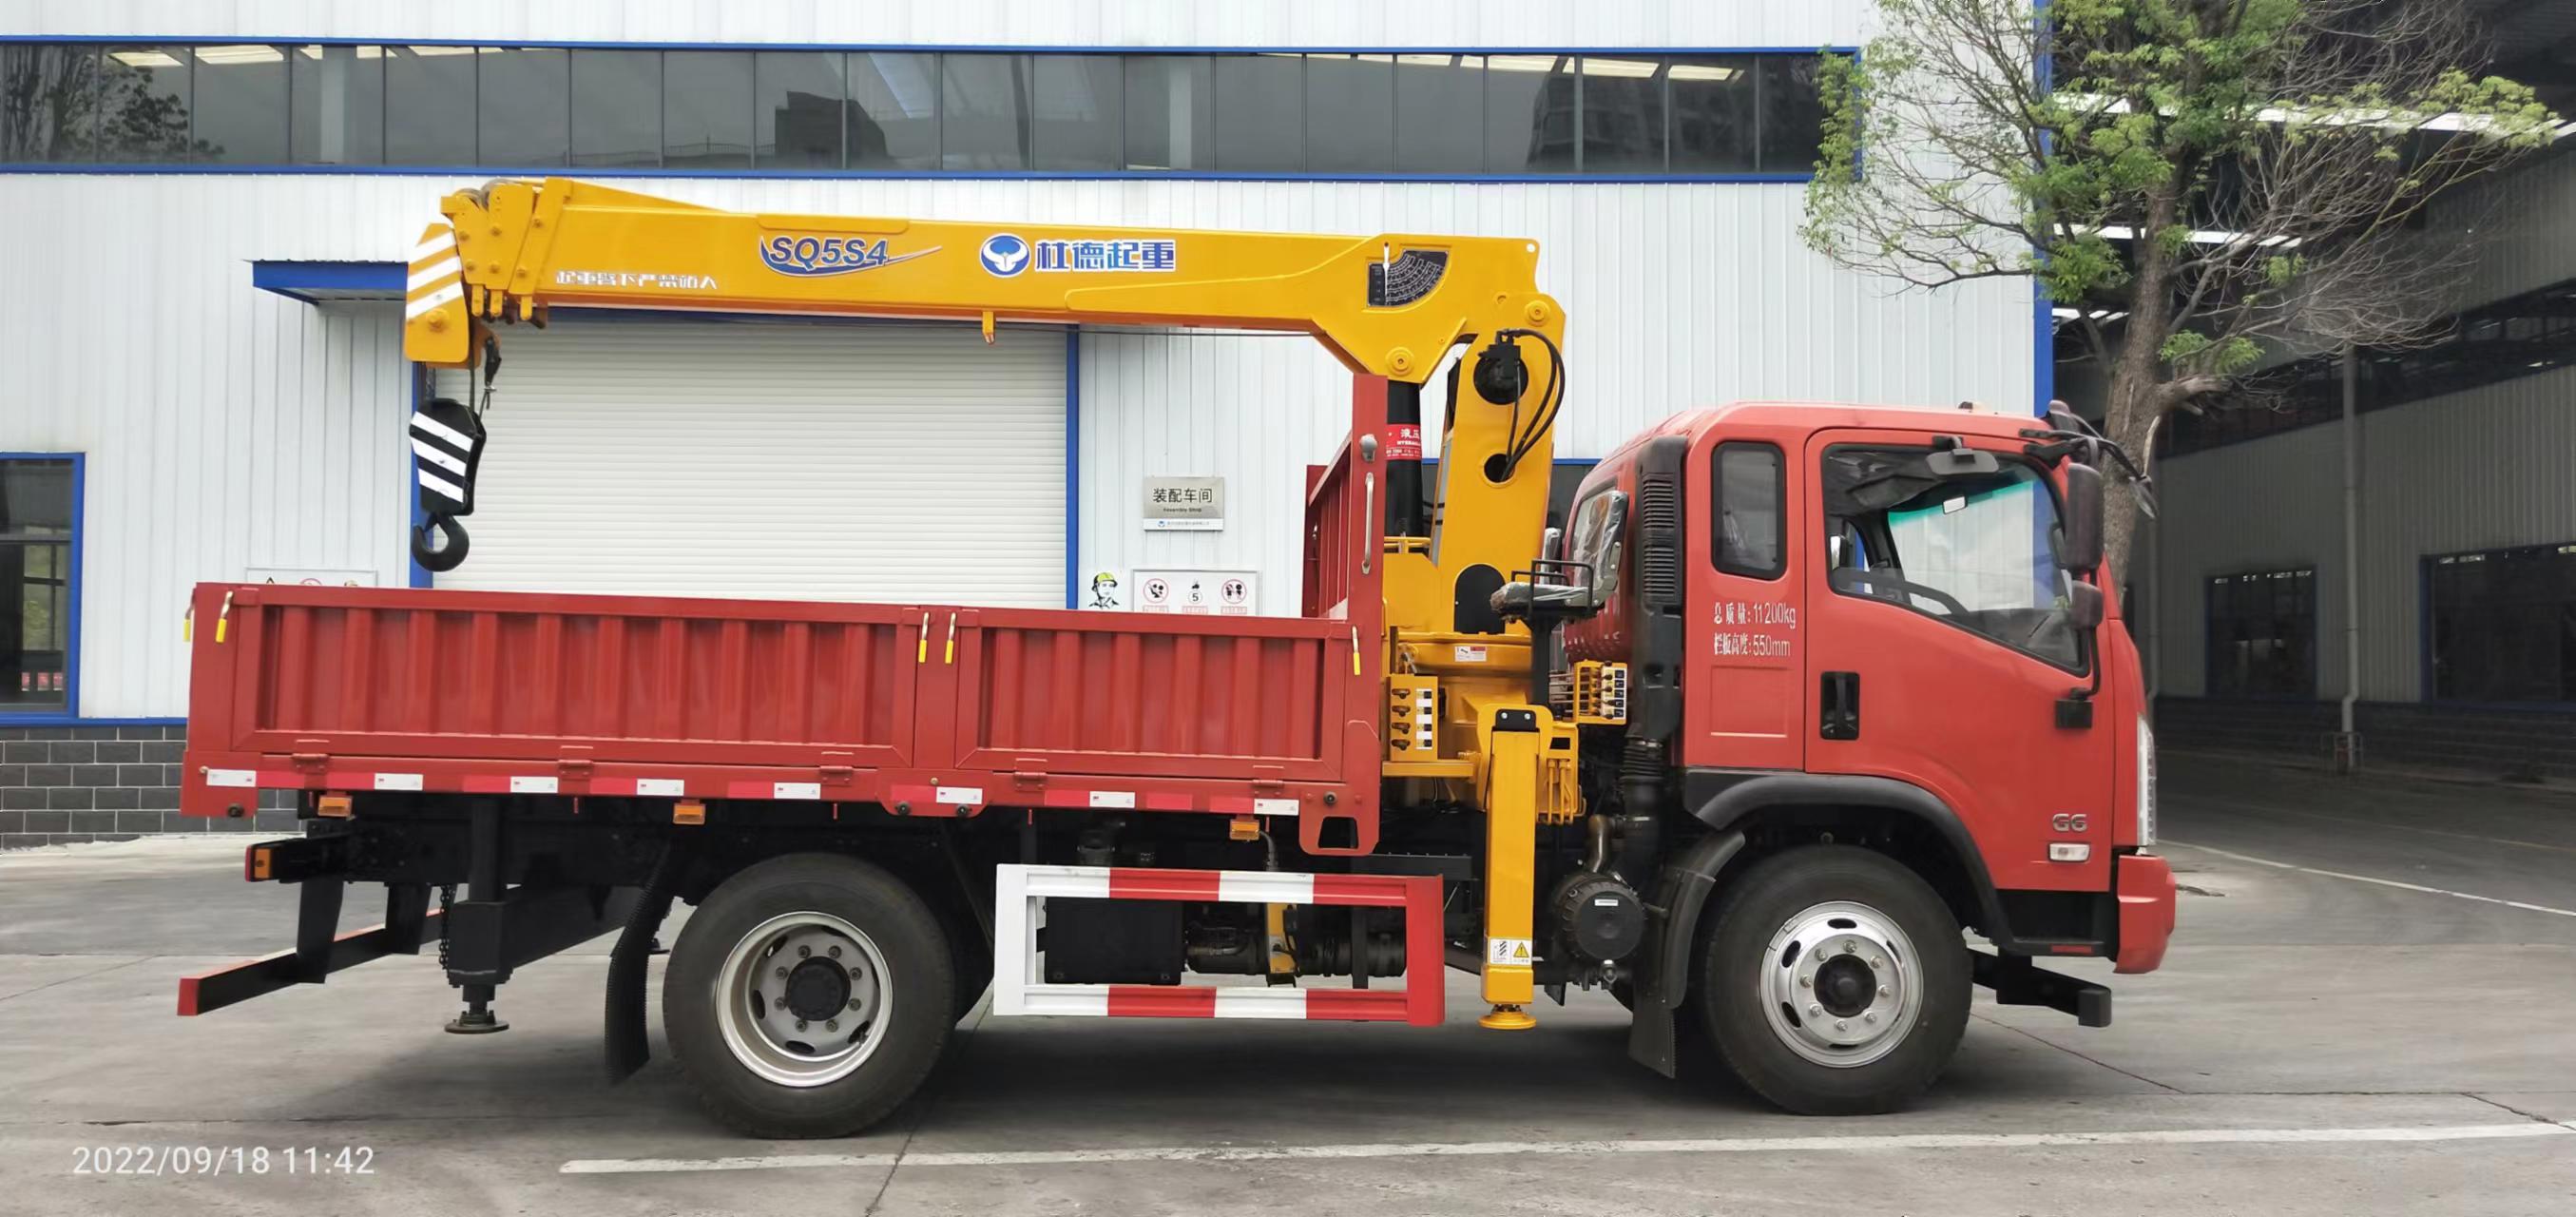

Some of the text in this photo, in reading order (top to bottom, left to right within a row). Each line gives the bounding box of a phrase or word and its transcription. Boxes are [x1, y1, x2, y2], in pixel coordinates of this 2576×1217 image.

[769, 236, 889, 271] SQ5S4
[1036, 241, 1175, 271] 杜德起重
[1152, 487, 1213, 503] 装配车间
[1192, 592, 1200, 602] 5
[2052, 813, 2087, 832] G6
